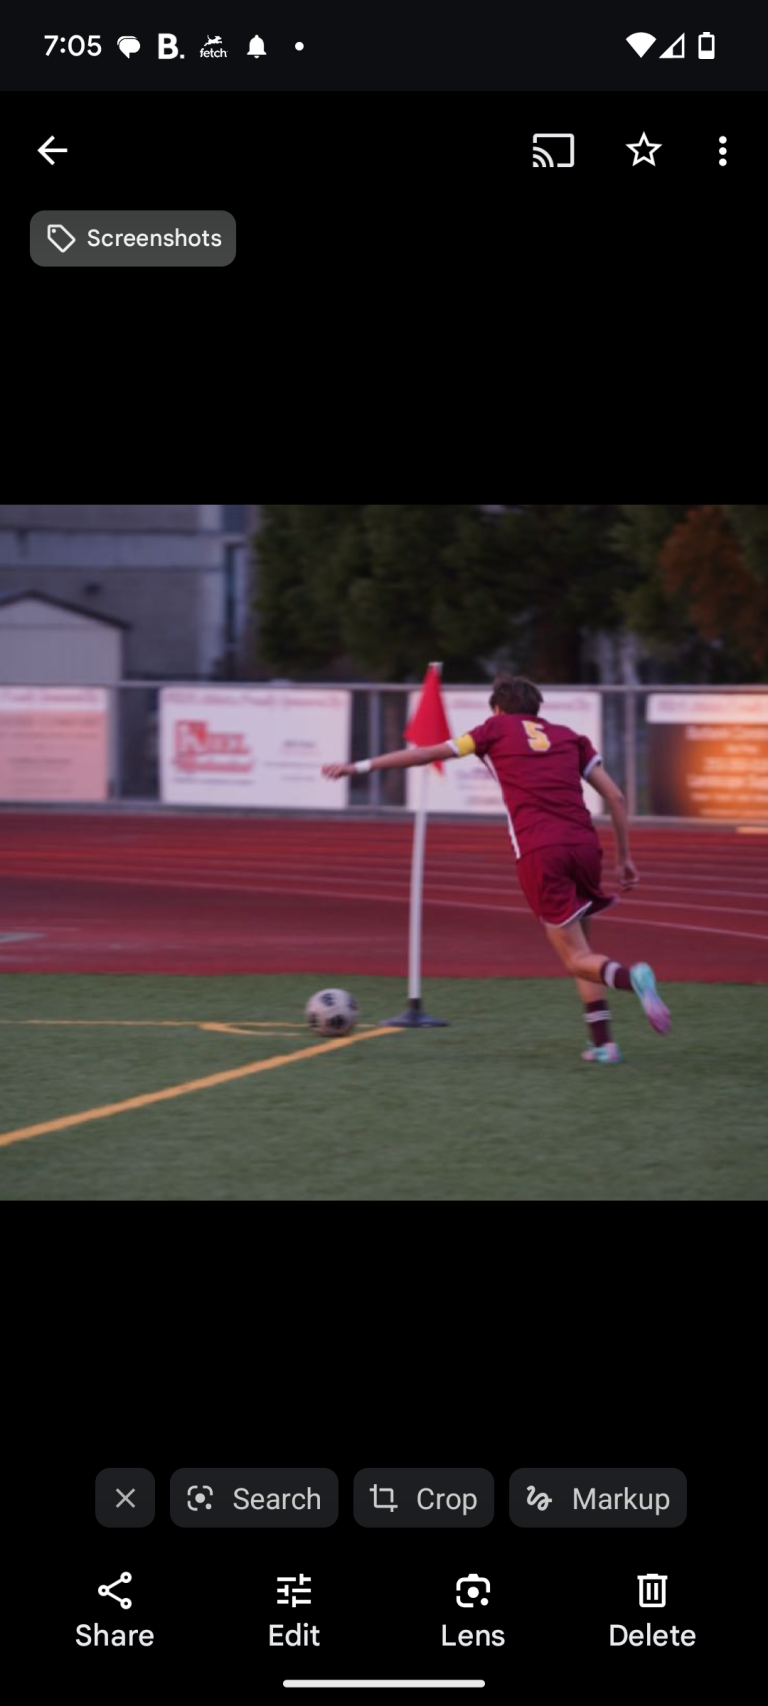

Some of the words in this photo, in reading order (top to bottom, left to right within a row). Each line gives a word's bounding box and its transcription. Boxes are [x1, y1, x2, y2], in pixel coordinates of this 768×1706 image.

[44, 34, 102, 57] 7:05
[199, 47, 228, 59] fetch
[86, 227, 222, 247] Screenshots
[521, 719, 551, 752] 5
[232, 1486, 322, 1510] Search
[416, 1486, 478, 1516] Crop
[572, 1486, 670, 1516] Markup
[75, 1622, 155, 1647] Share
[268, 1622, 321, 1647] Edit
[441, 1623, 506, 1647] Lens
[609, 1622, 696, 1647] Delete
